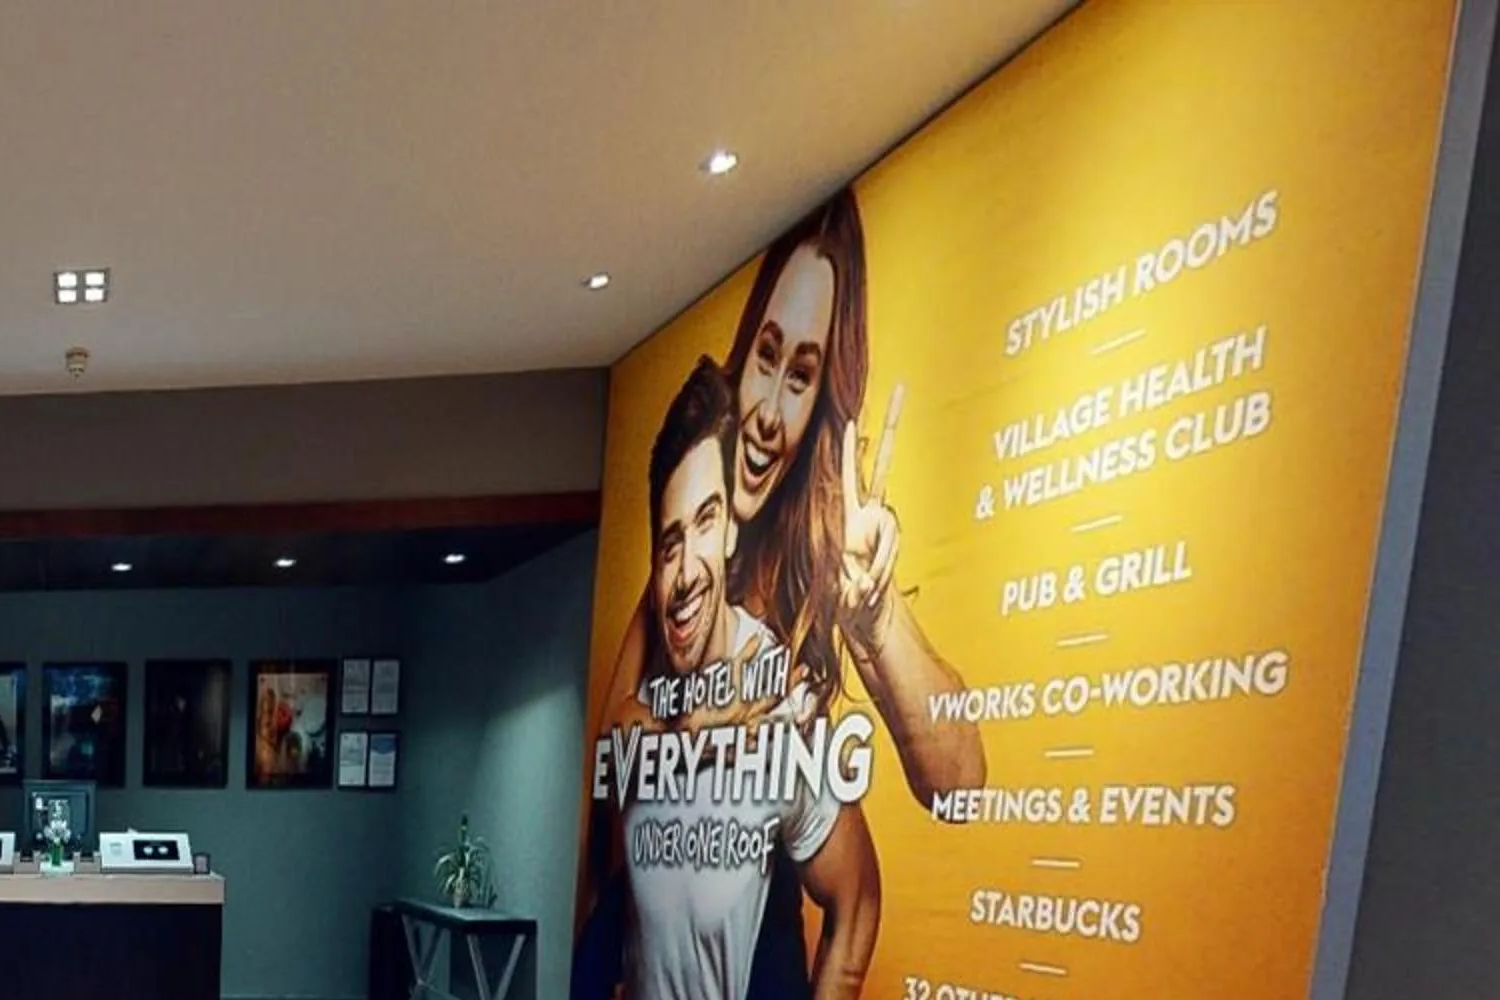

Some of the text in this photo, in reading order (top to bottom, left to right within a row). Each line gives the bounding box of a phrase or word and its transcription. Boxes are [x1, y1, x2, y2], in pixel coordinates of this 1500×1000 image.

[1004, 190, 1278, 356] STYLISH ROOMS
[993, 326, 1267, 460] VILLAGE HEALTH
[974, 391, 1271, 520] & WELLNESS CLUB
[1001, 541, 1192, 616] PUB & GRILL
[650, 647, 791, 718] THE HOTEL WITH
[928, 650, 1289, 724] VWORKS CO-WORKING
[592, 713, 874, 810] EVERYTHING
[931, 784, 1236, 827] MEETINGS & EVENTS
[635, 816, 780, 875] UNDER ONE ROOF
[970, 890, 1141, 942] STARBUCKS
